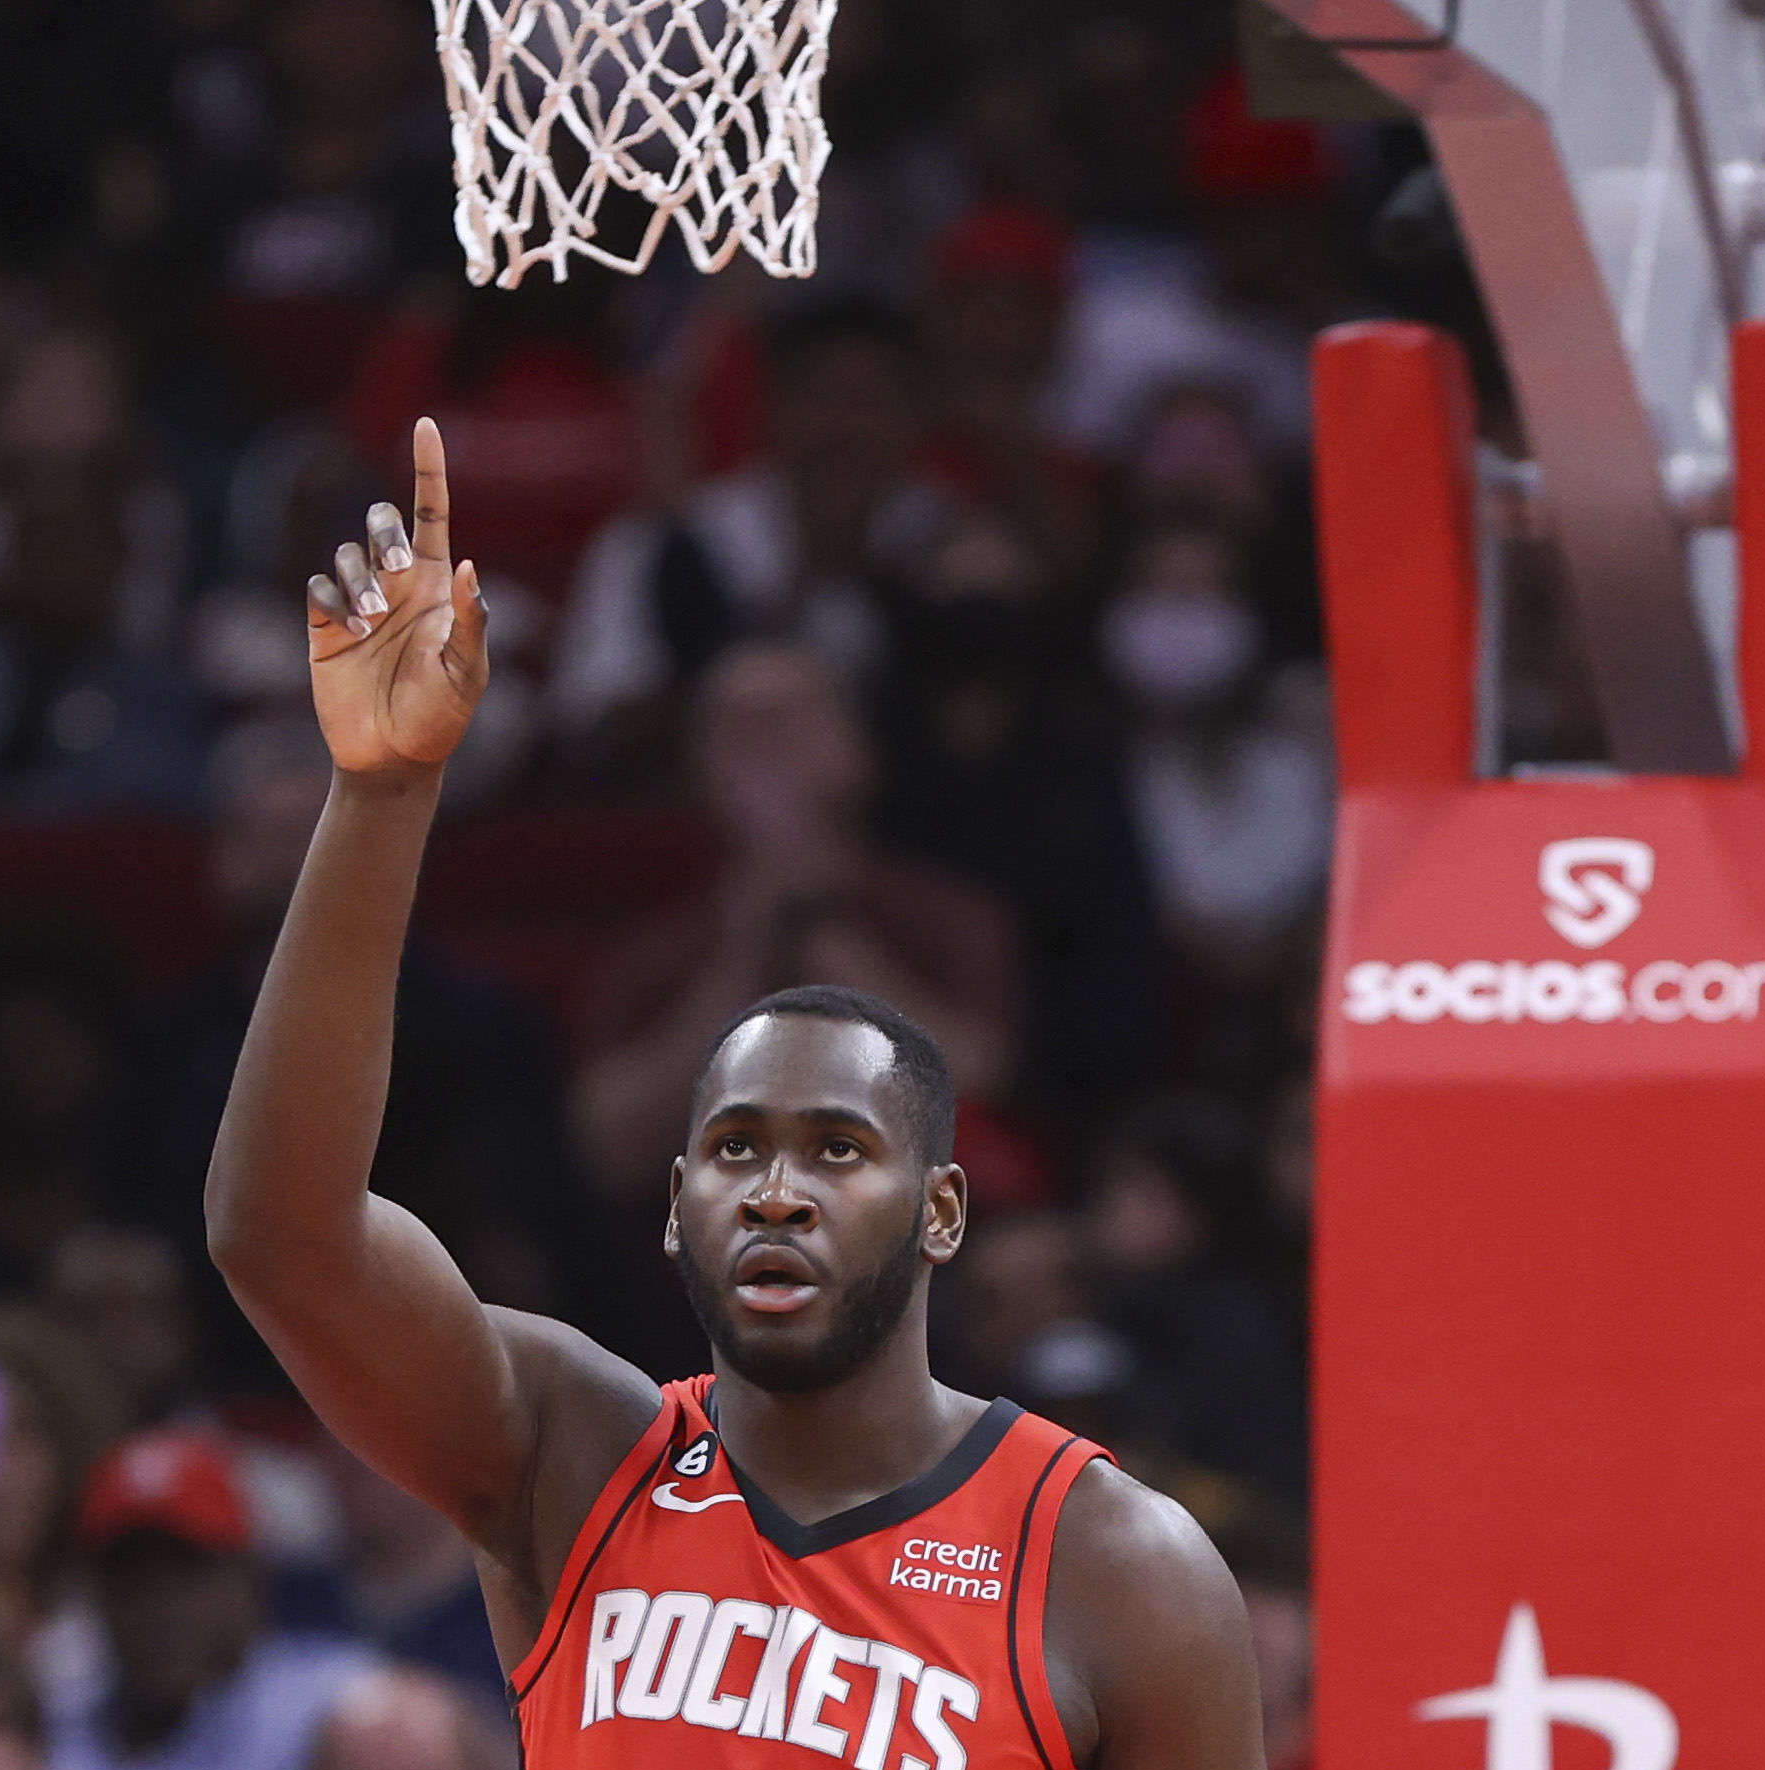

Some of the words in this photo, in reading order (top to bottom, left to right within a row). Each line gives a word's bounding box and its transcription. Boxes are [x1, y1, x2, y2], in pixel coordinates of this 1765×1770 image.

[674, 1439, 709, 1476] 6
[902, 1537, 1003, 1573] credit
[889, 1558, 1003, 1602] karma
